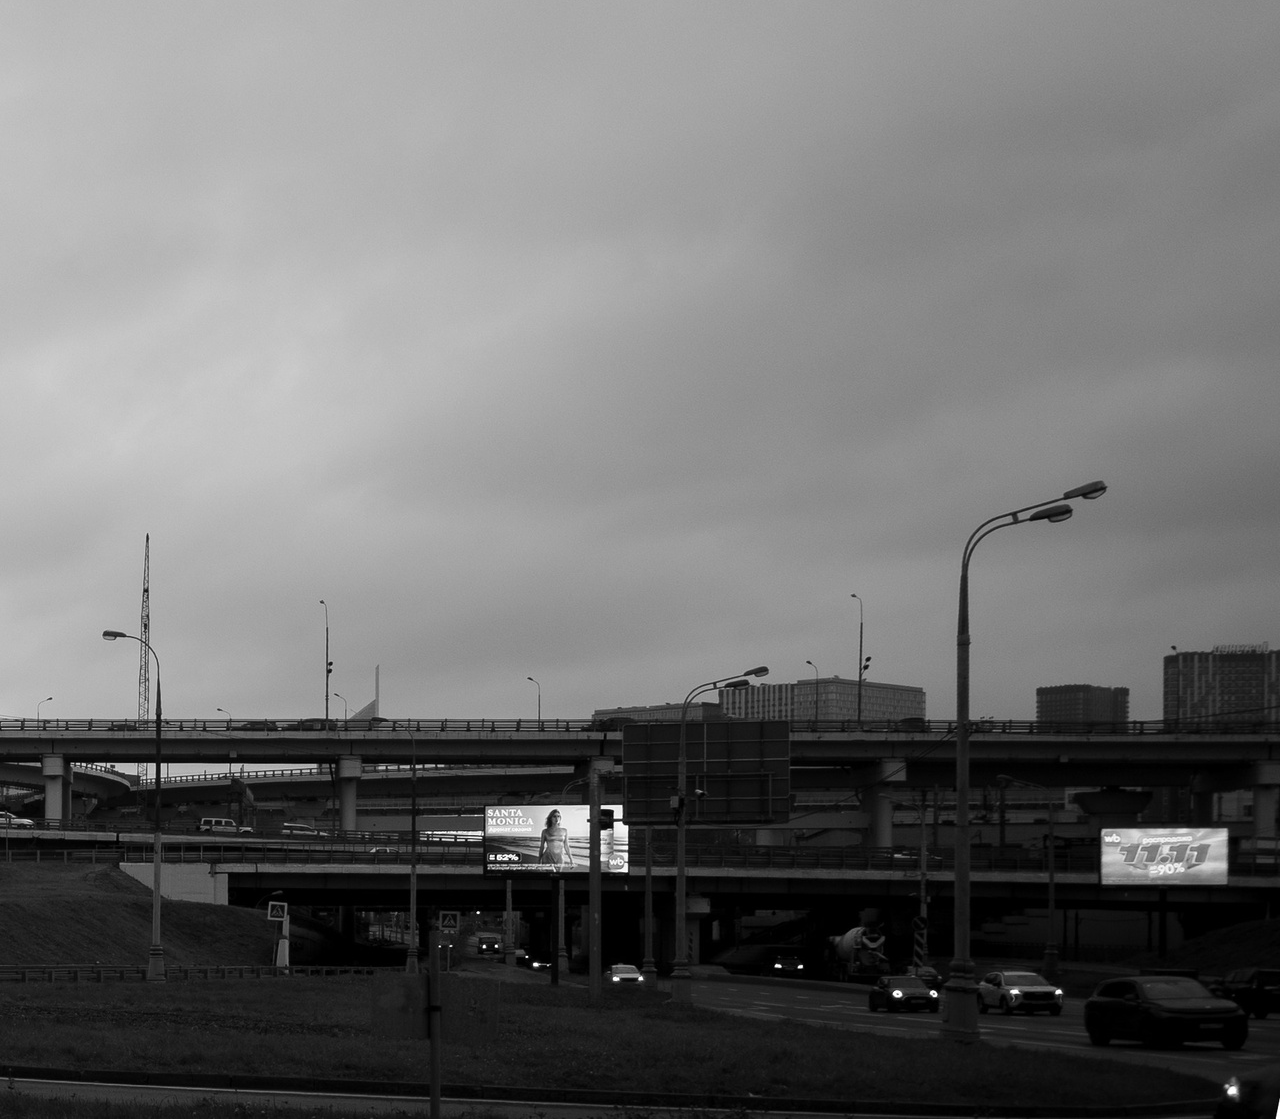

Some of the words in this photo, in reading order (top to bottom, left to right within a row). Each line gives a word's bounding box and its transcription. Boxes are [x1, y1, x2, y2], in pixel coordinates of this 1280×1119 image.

[487, 809, 523, 817] SANTA
[487, 818, 534, 826] MONICA
[1104, 834, 1120, 843] wb
[1119, 843, 1211, 864] 11.11
[609, 857, 624, 866] wb
